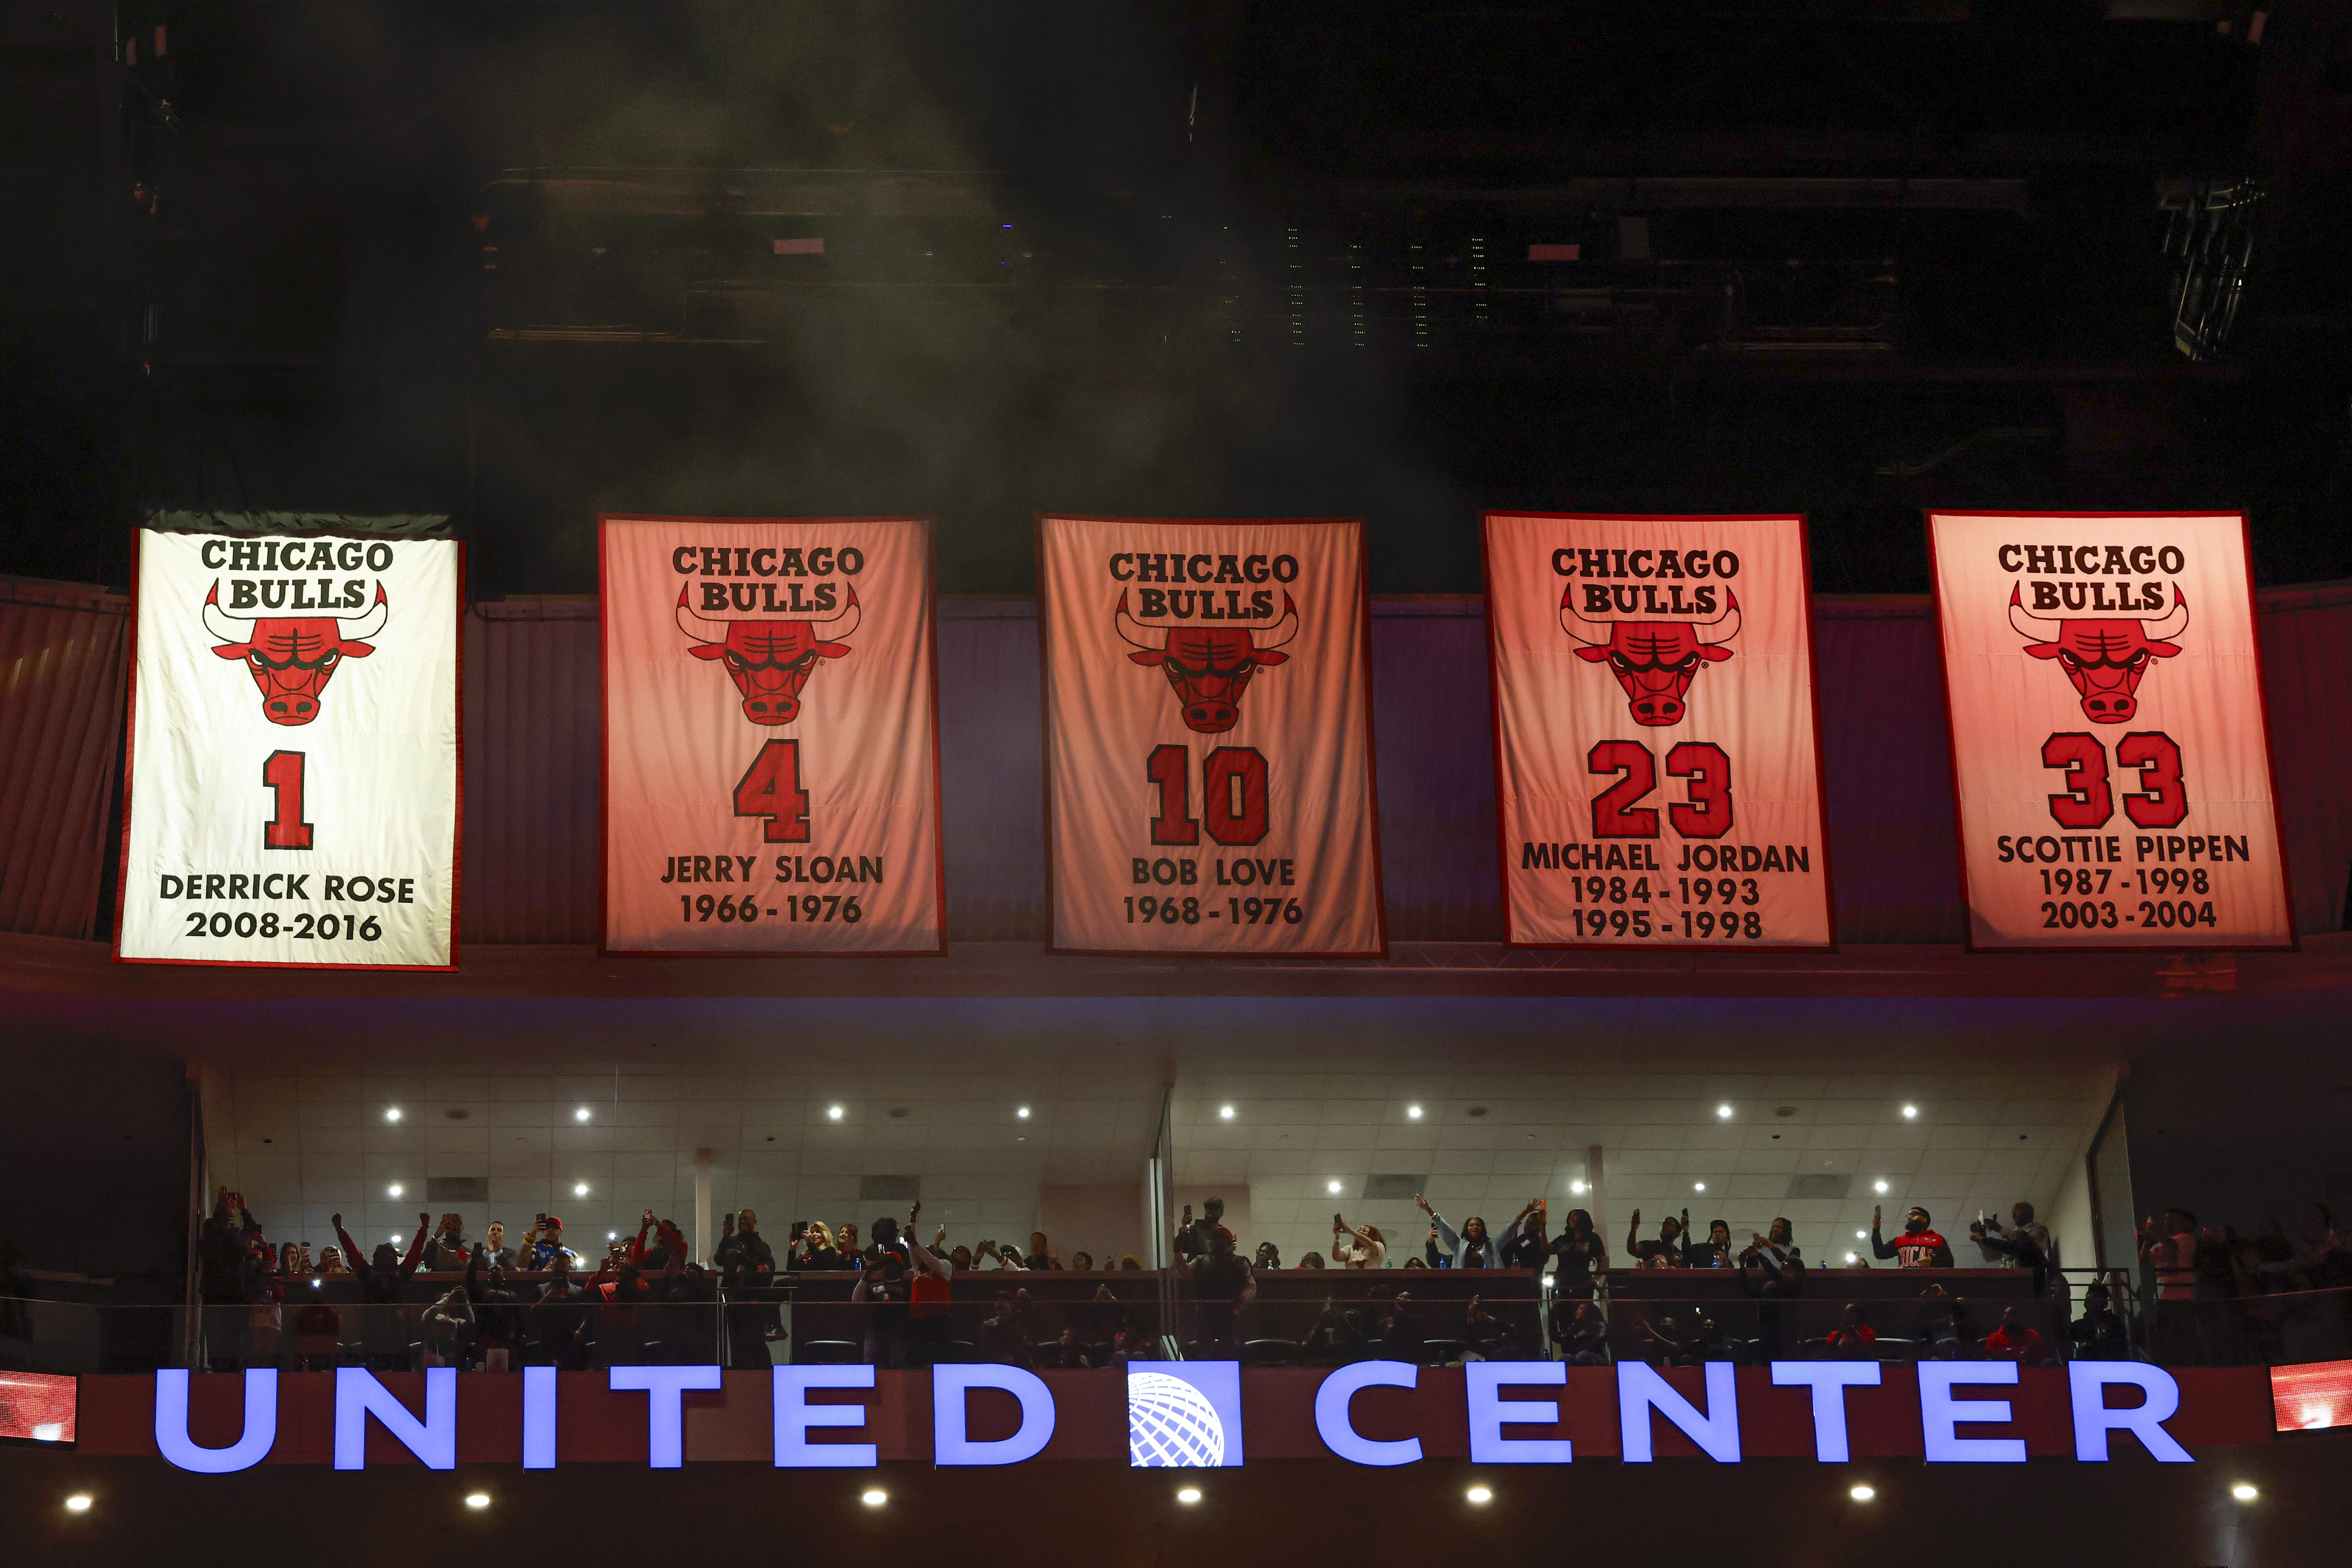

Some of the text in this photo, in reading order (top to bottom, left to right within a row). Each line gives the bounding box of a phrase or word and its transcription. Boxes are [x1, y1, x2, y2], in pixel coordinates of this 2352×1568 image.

[201, 540, 393, 572] CHICAGO
[672, 546, 863, 577] CHICAGO
[1109, 553, 1299, 583] CHICAGO
[1552, 548, 1739, 579] CHICAGO
[1998, 544, 2184, 575] CHICAGO
[229, 579, 365, 609] BULLS
[700, 582, 837, 613] BULLS
[1139, 588, 1274, 619] BULLS
[1584, 584, 1717, 615] BULLS
[2033, 581, 2163, 610] BULLS
[733, 739, 810, 843] 4
[1147, 744, 1270, 846] 10
[1587, 740, 1734, 839] 23
[2040, 731, 2188, 829] 33
[263, 750, 314, 850] 1
[1521, 842, 1809, 872] MICHAEL JORDAN
[1997, 835, 2249, 862] SCOTTIE PIPPEN
[661, 856, 883, 883] JERRY SLOAN
[1132, 857, 1295, 885] BOB LOVE
[160, 873, 413, 904] DERRICK ROSE
[185, 912, 382, 941] 2008-2016
[155, 1360, 2195, 1475] UNITED CENTER
